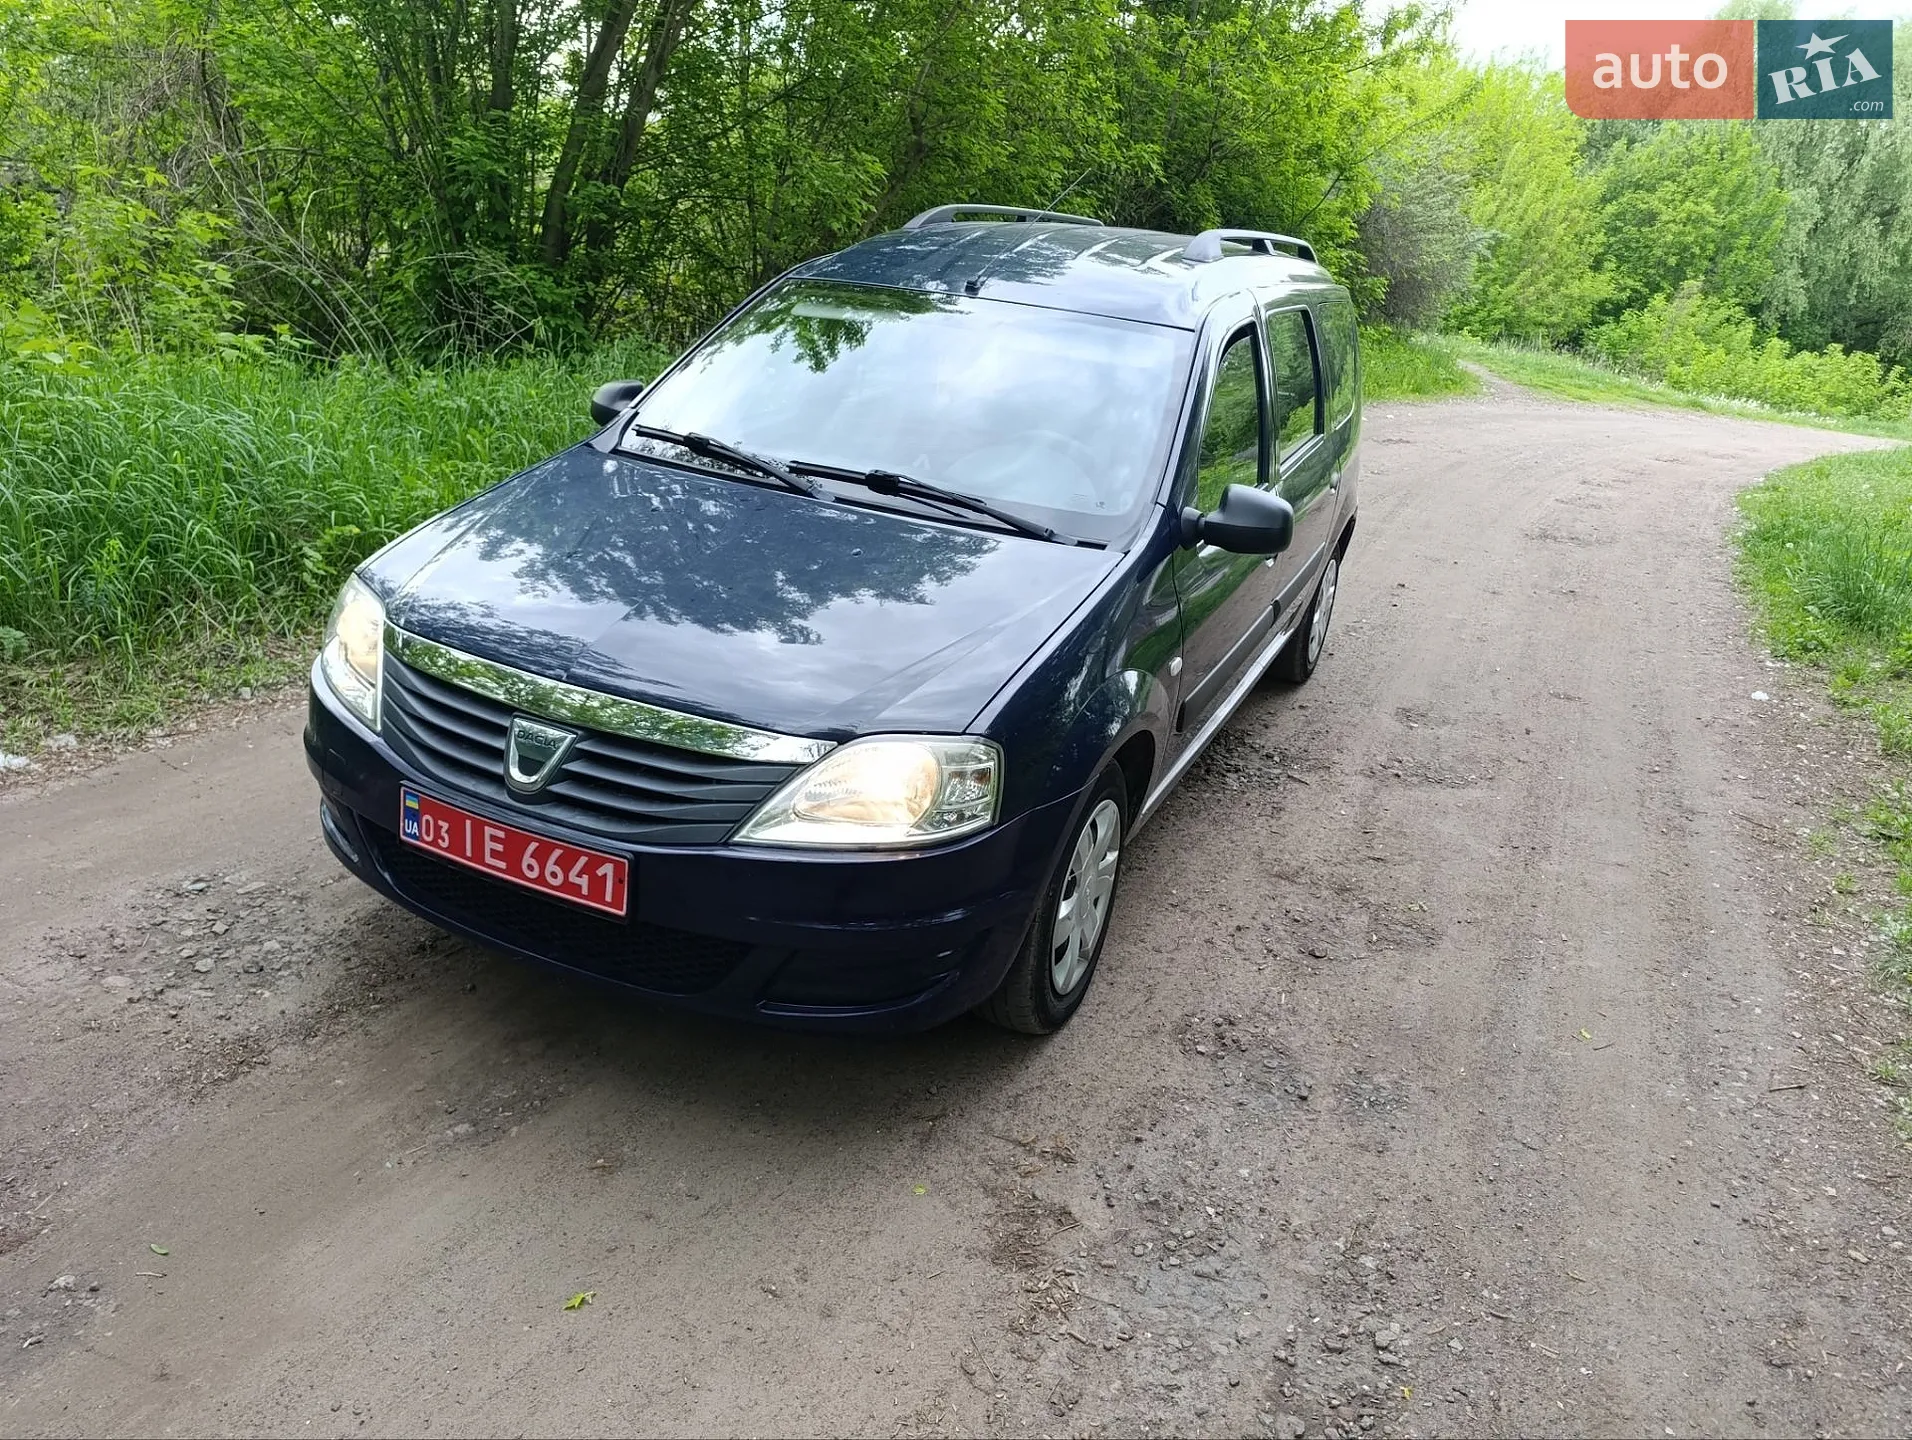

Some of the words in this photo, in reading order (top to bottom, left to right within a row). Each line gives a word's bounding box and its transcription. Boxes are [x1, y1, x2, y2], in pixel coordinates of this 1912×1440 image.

[517, 730, 557, 749] DACIA
[405, 818, 419, 836] UA
[421, 814, 450, 849] 03
[465, 819, 507, 870] IE
[521, 842, 614, 902] 6641
